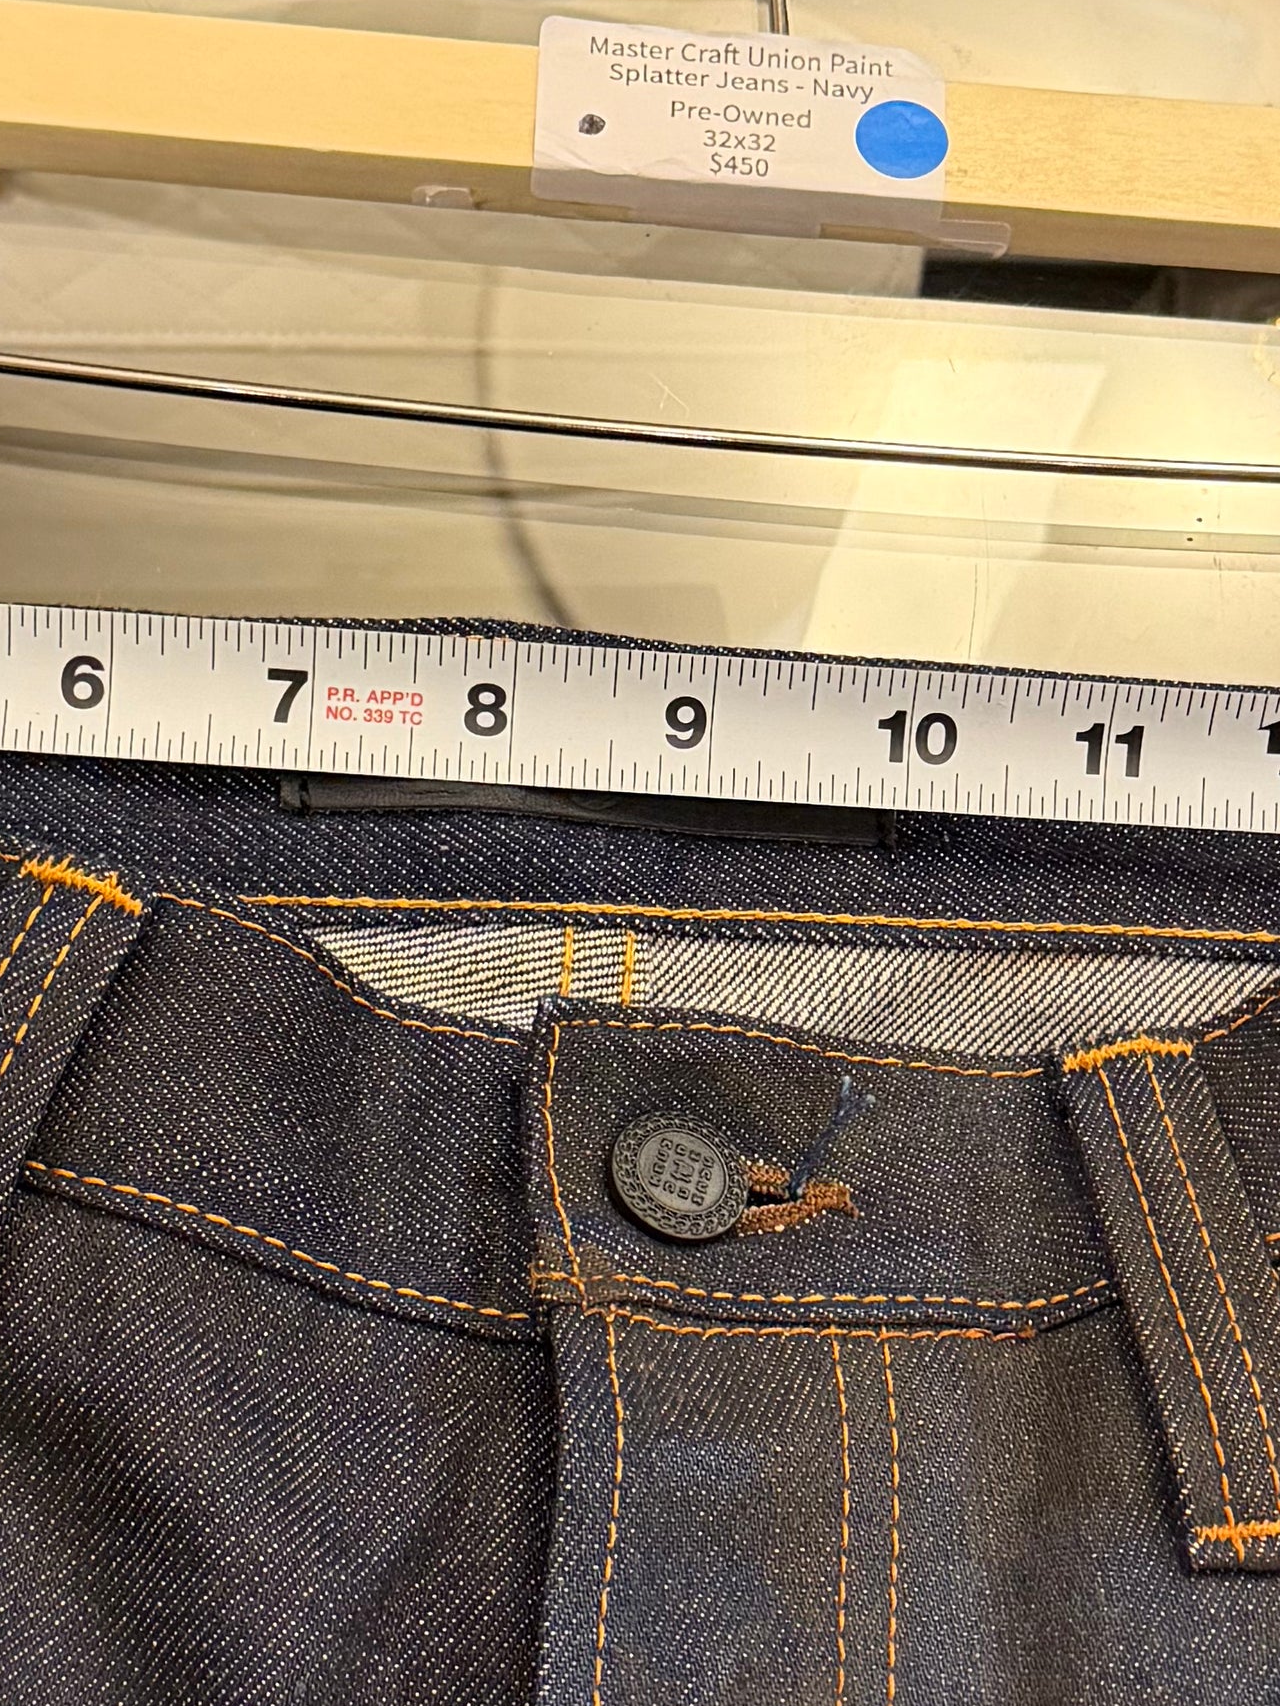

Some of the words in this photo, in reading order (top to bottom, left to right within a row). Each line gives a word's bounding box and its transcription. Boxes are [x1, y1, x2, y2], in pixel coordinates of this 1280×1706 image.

[589, 36, 674, 62] Master
[680, 42, 740, 66] Craft
[748, 47, 821, 72] Union
[831, 53, 895, 78] Paint
[609, 63, 710, 88] Splatter
[716, 70, 789, 94] Jeans
[813, 79, 875, 104] Navy
[670, 100, 812, 130] Pre-Owned
[703, 130, 777, 153] 32x32
[709, 153, 769, 178] $450
[327, 686, 360, 703] P.R.
[366, 690, 423, 707] APP'D
[60, 654, 106, 710] 6
[266, 668, 310, 724] 7
[463, 683, 509, 737] 8
[664, 694, 708, 749] 9
[877, 709, 958, 765] 10
[1076, 722, 1146, 779] 11
[326, 705, 357, 721] NO.
[363, 707, 394, 724] 339
[399, 710, 423, 726] TC
